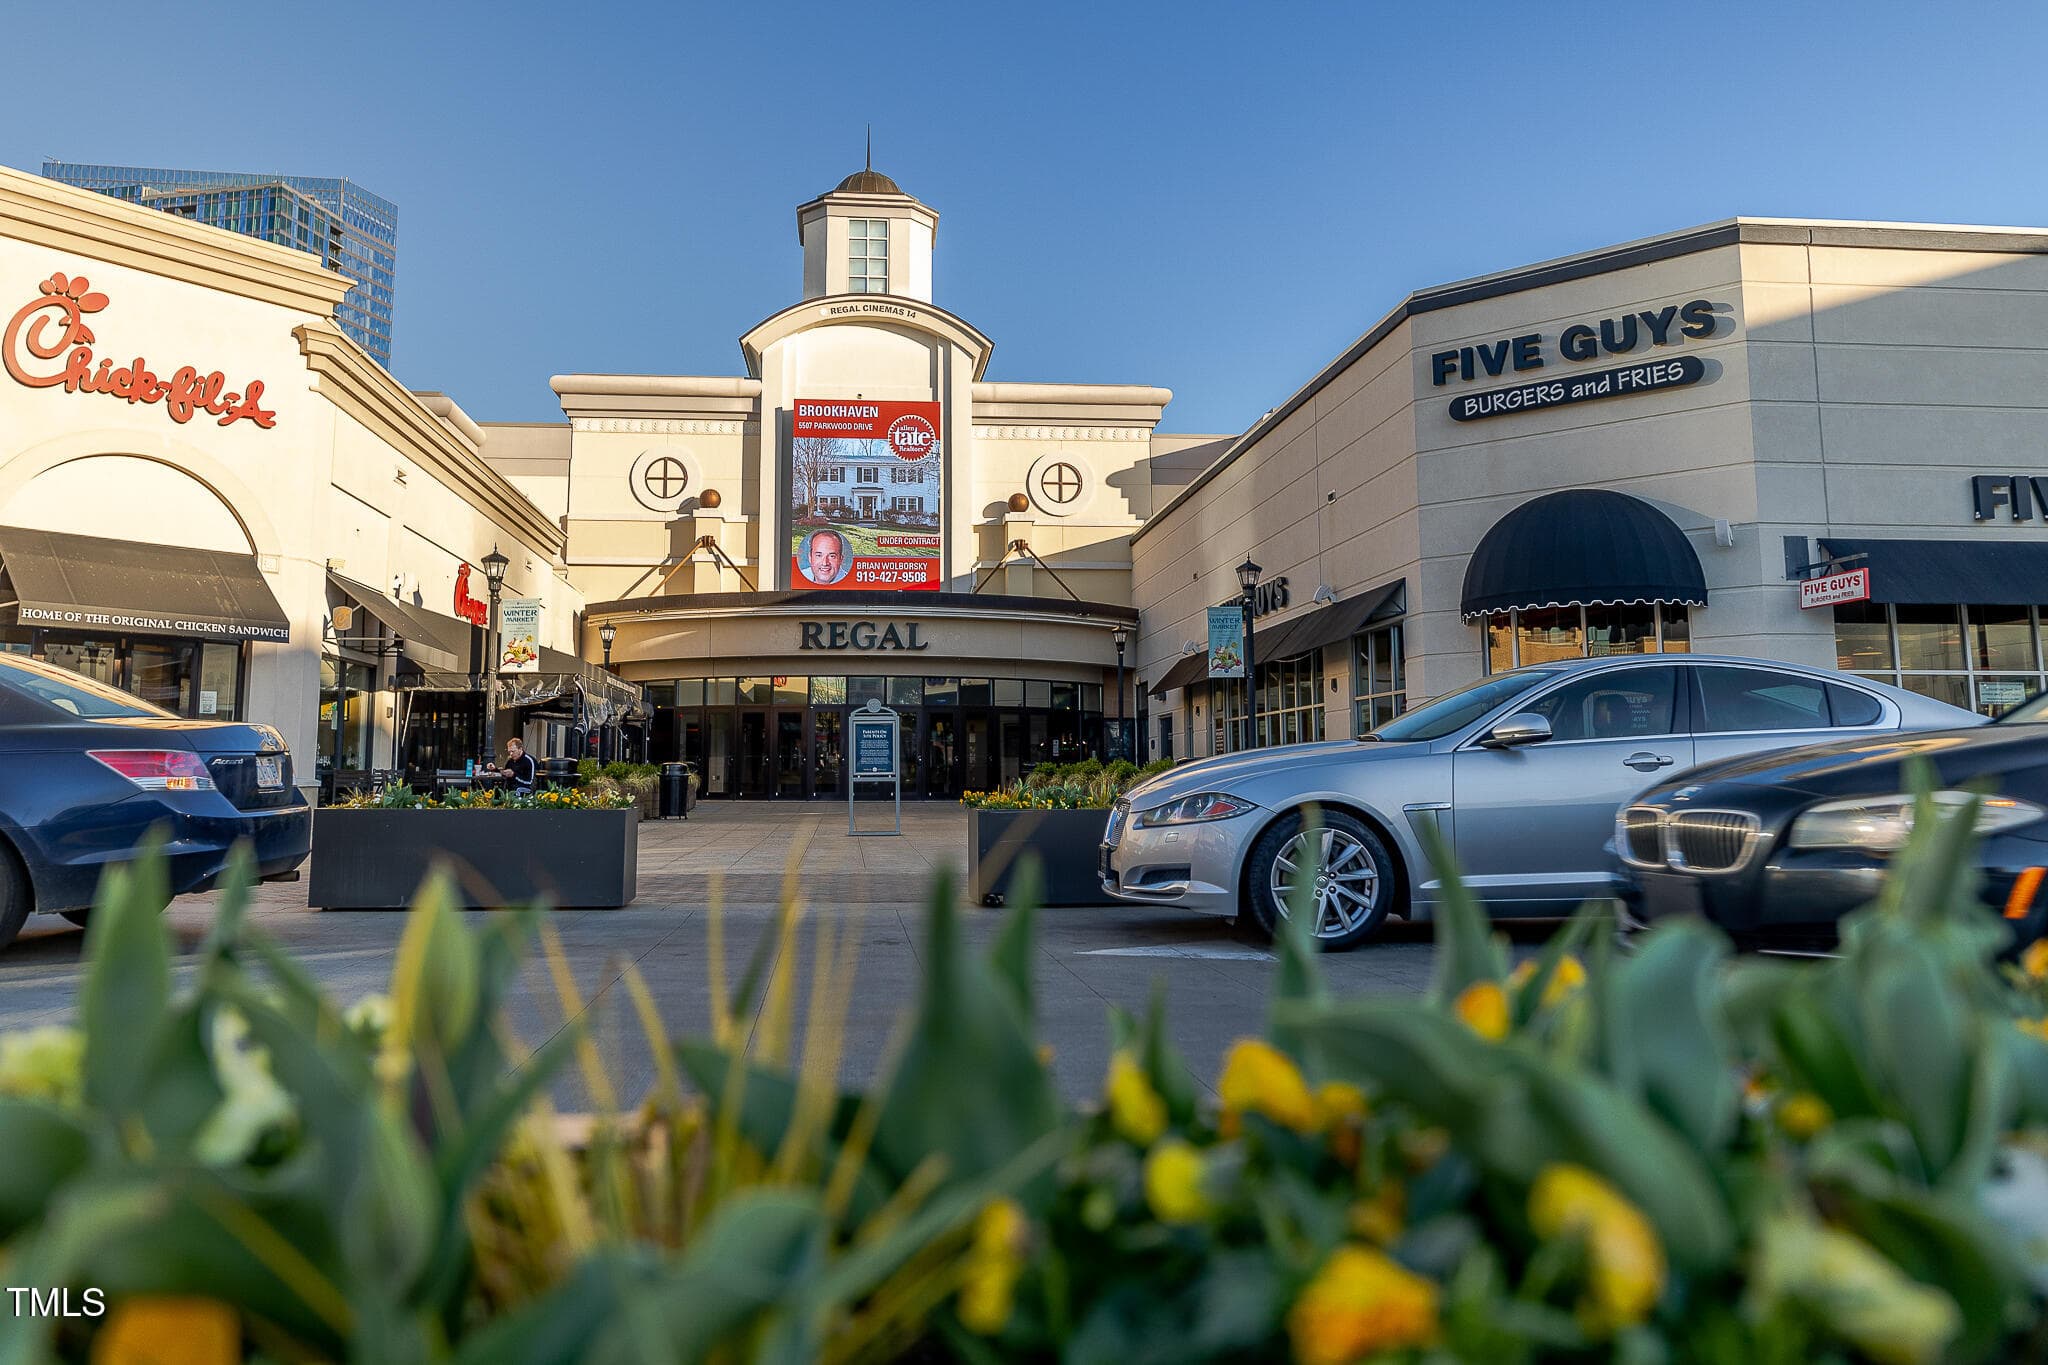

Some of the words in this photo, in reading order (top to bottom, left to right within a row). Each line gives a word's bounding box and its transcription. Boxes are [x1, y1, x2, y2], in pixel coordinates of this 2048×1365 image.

[830, 305, 861, 315] REGAL
[862, 304, 905, 316] CINEMAS
[906, 310, 916, 318] 14
[2, 272, 277, 429] Chick-fil-A
[1432, 333, 1544, 386] FIVE
[1559, 300, 1717, 361] GUYS
[1464, 383, 1565, 416] BURGERS
[1571, 378, 1610, 397] and
[1618, 362, 1684, 390] FRIES
[799, 404, 879, 418] BROOKHAVEN
[798, 421, 813, 429] 5507
[813, 422, 853, 431] PARKWOOD
[853, 423, 873, 431] DRIVE
[892, 426, 931, 446] tate
[879, 536, 903, 545] UNDER
[903, 536, 939, 545] CONTRACT
[856, 562, 880, 570] BRIAN
[856, 571, 927, 582] 919-427-9508
[1804, 582, 1827, 596] FIVE
[1830, 575, 1861, 590] GUYS
[1253, 577, 1289, 617] UYS
[21, 608, 61, 621] HOME
[64, 611, 82, 622] OF
[84, 613, 110, 625] THE
[111, 615, 173, 630] ORIGINAL
[174, 620, 227, 634] CHICKEN
[228, 624, 289, 638] SANDWICH
[503, 609, 538, 617] WINTER
[799, 621, 929, 651] REGAL
